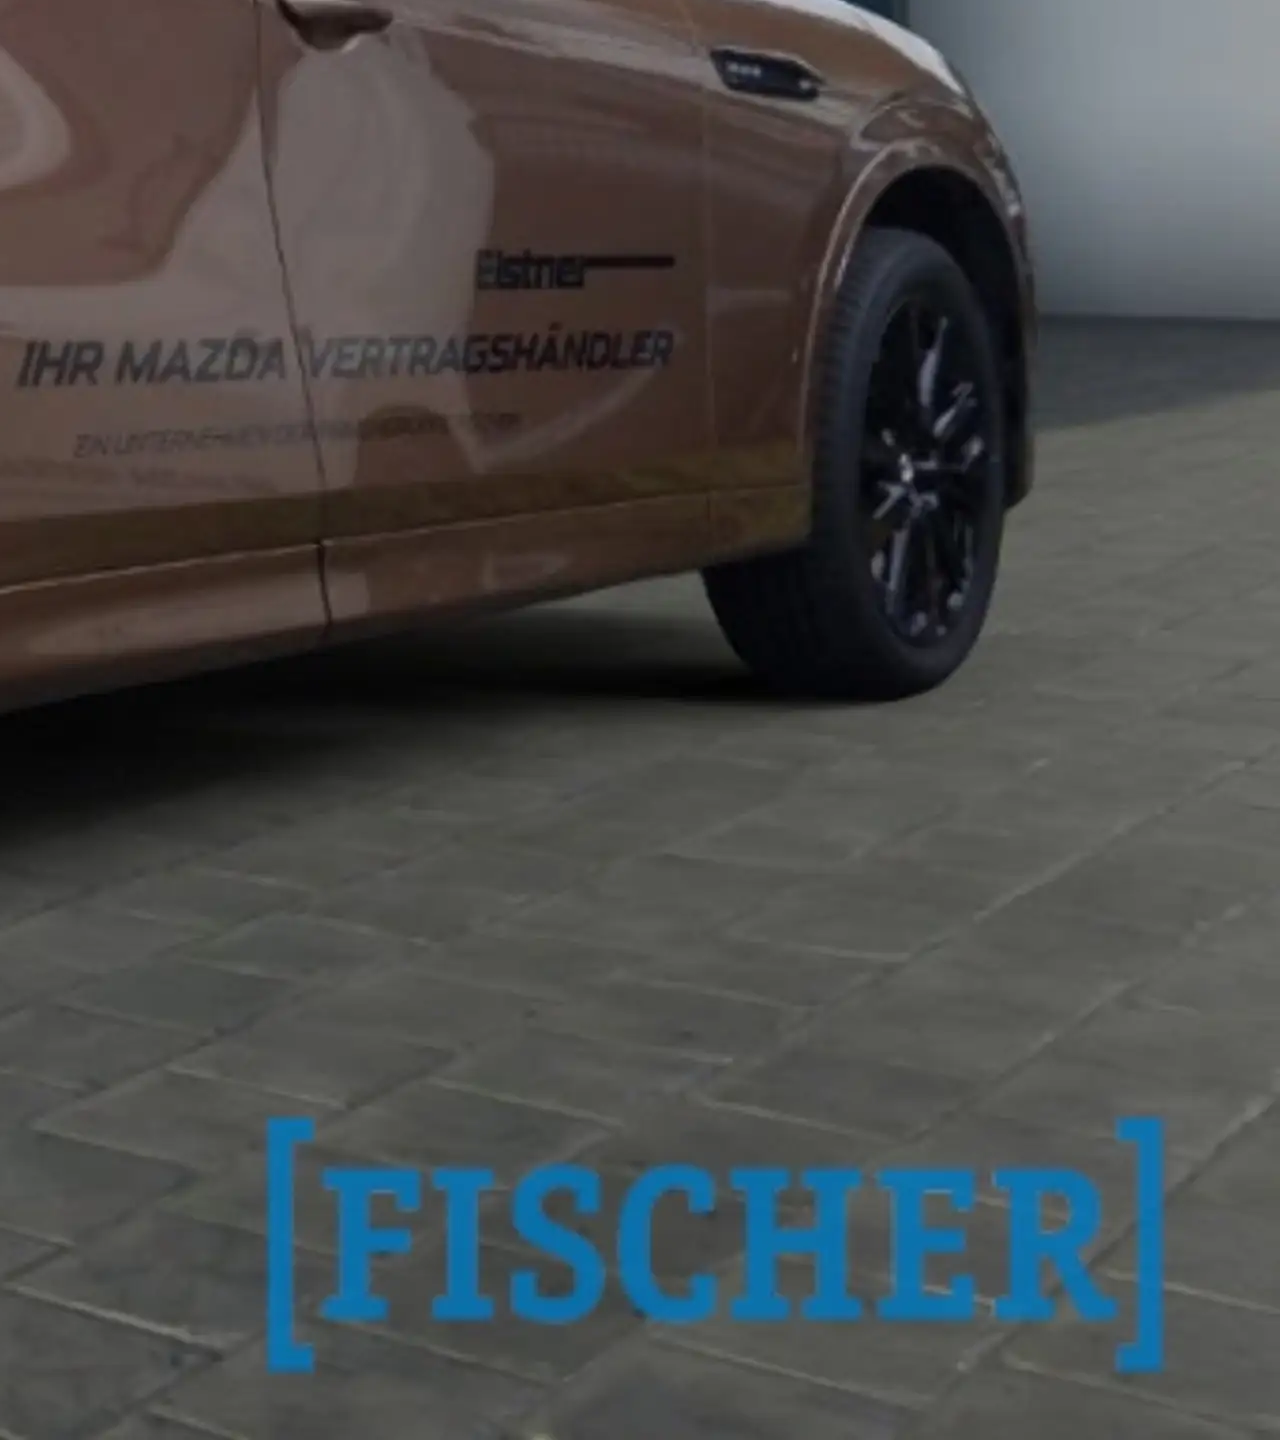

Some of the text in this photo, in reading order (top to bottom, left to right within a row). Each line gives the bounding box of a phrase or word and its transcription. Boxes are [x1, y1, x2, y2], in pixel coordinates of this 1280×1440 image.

[476, 248, 676, 290] Elstner
[15, 320, 674, 389] IHR MAZDA VERTRAGSHÄNDLER
